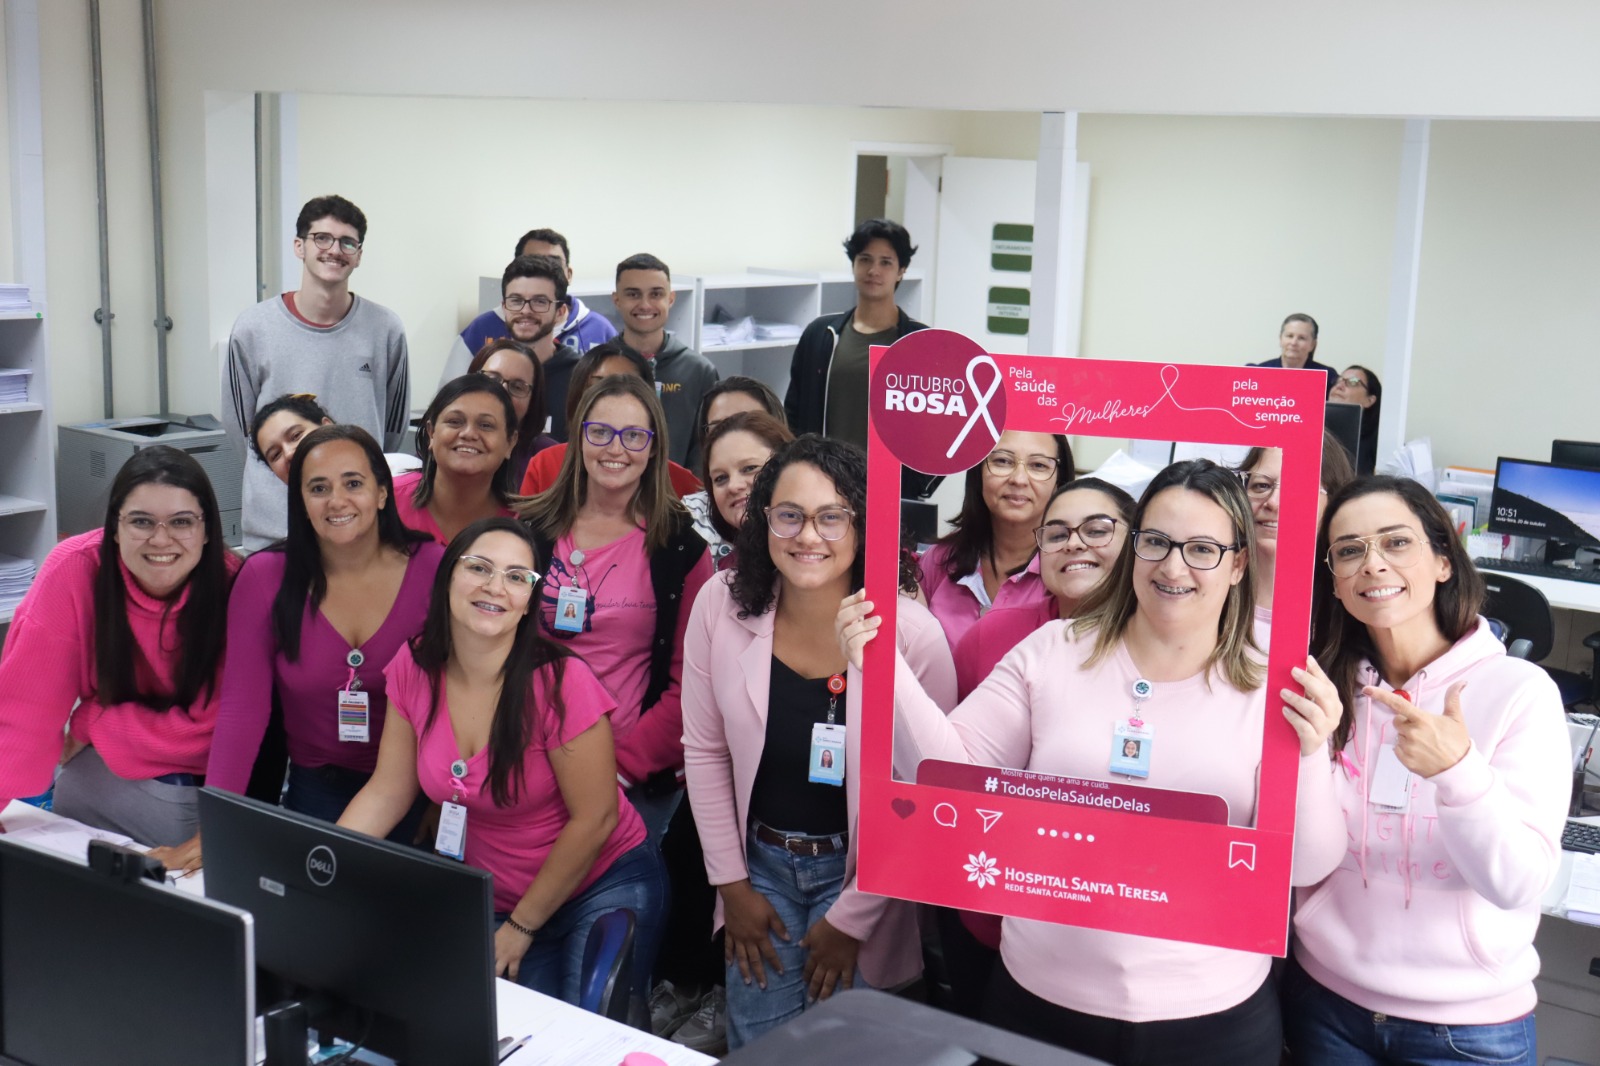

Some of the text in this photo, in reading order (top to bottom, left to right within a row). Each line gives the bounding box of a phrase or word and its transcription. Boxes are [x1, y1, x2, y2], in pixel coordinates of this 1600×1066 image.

[1009, 366, 1033, 379] Pela
[885, 373, 966, 394] OUTUBRO
[1014, 379, 1056, 393] saúde
[1232, 378, 1258, 392] pela
[885, 389, 968, 417] ROSA
[1037, 394, 1058, 407] das
[1231, 395, 1296, 409] prevenção
[1050, 399, 1150, 430] Mulheres
[1255, 412, 1303, 425] sempre.
[1497, 507, 1517, 518] 10:51
[1000, 769, 1023, 778] Mostre
[1024, 772, 1037, 781] que
[1037, 774, 1056, 783] quem
[1057, 776, 1065, 784] se
[1066, 778, 1081, 786] ama
[310, 858, 333, 874] DELL
[1004, 866, 1169, 903] HOSPITAL SANTA TERESA
[1004, 882, 1092, 903] REDE SANTA CATARINA
